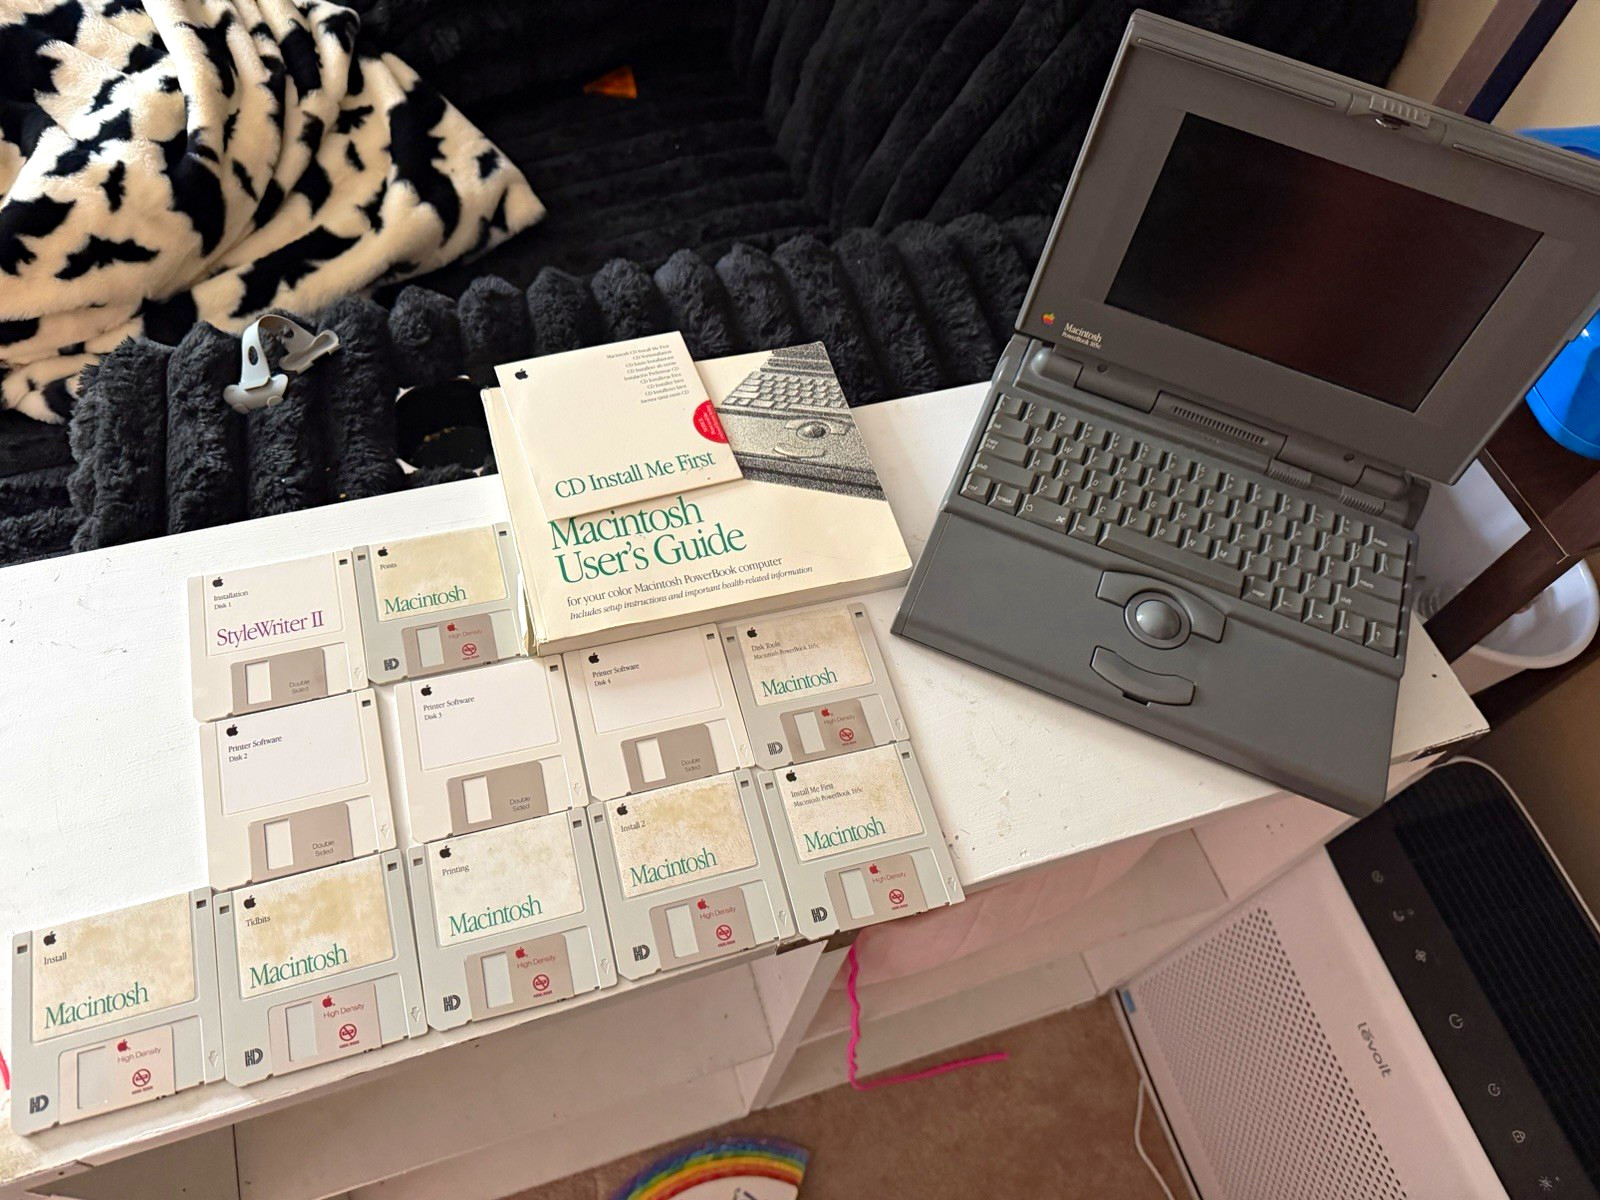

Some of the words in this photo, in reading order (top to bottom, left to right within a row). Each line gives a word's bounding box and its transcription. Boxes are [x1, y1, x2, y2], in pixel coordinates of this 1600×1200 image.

[1062, 332, 1089, 345] PowerBook
[1064, 322, 1102, 342] Macintosh
[555, 477, 586, 498] CD
[588, 463, 643, 490] Install
[645, 460, 675, 478] Me
[676, 452, 716, 471] First
[548, 495, 705, 551] Macintosh
[555, 541, 650, 583] User's
[654, 523, 747, 565] Guide
[567, 595, 582, 607] for
[583, 590, 606, 605] your
[608, 586, 633, 598] color
[634, 577, 682, 594] Macintosh
[684, 566, 737, 584] PowerBook
[738, 556, 783, 575] computer
[213, 590, 248, 601] Installation
[385, 585, 467, 614] Macintosh
[570, 607, 602, 620] Includes
[603, 603, 623, 616] setup
[624, 592, 667, 608] instructions
[668, 591, 684, 601] and
[685, 583, 720, 600] important
[722, 572, 769, 589] health-related
[771, 565, 813, 581] information
[217, 618, 308, 648] StyleWriter
[312, 610, 324, 628] II
[463, 629, 483, 638] Density
[754, 650, 779, 660] Macintosh
[780, 645, 807, 655] PowerBook
[592, 669, 613, 678] Printer
[614, 663, 640, 673] Software
[289, 679, 310, 688] Double
[762, 667, 838, 697] Macintosh
[292, 686, 308, 694] Sided
[423, 702, 445, 711] Printer
[447, 696, 475, 707] Software
[837, 714, 855, 722] Density
[228, 742, 251, 753] Printer
[252, 735, 282, 748] Software
[791, 788, 809, 798] Install
[821, 783, 834, 792] First
[510, 796, 530, 804] Double
[793, 796, 820, 807] Macintosh
[822, 790, 850, 801] PowerBook
[513, 803, 530, 812] Sided
[620, 822, 640, 832] Install
[804, 816, 886, 852] Macintosh
[312, 839, 334, 849] Double
[315, 848, 334, 856] Sided
[442, 864, 470, 876] Printing
[630, 847, 718, 887] Macintosh
[872, 876, 886, 884] High
[887, 872, 906, 880] Density
[245, 914, 271, 927] Tidbits
[449, 895, 543, 937] Macintosh
[700, 911, 714, 920] High
[715, 906, 736, 916] Density
[44, 952, 67, 965] Install
[250, 943, 349, 989] Macintosh
[517, 960, 532, 969] High
[534, 954, 556, 964] Density
[44, 982, 149, 1029] Macintosh
[323, 1009, 339, 1019] High
[340, 1002, 364, 1014] Density
[117, 1053, 134, 1063] High
[136, 1046, 161, 1058] Density
